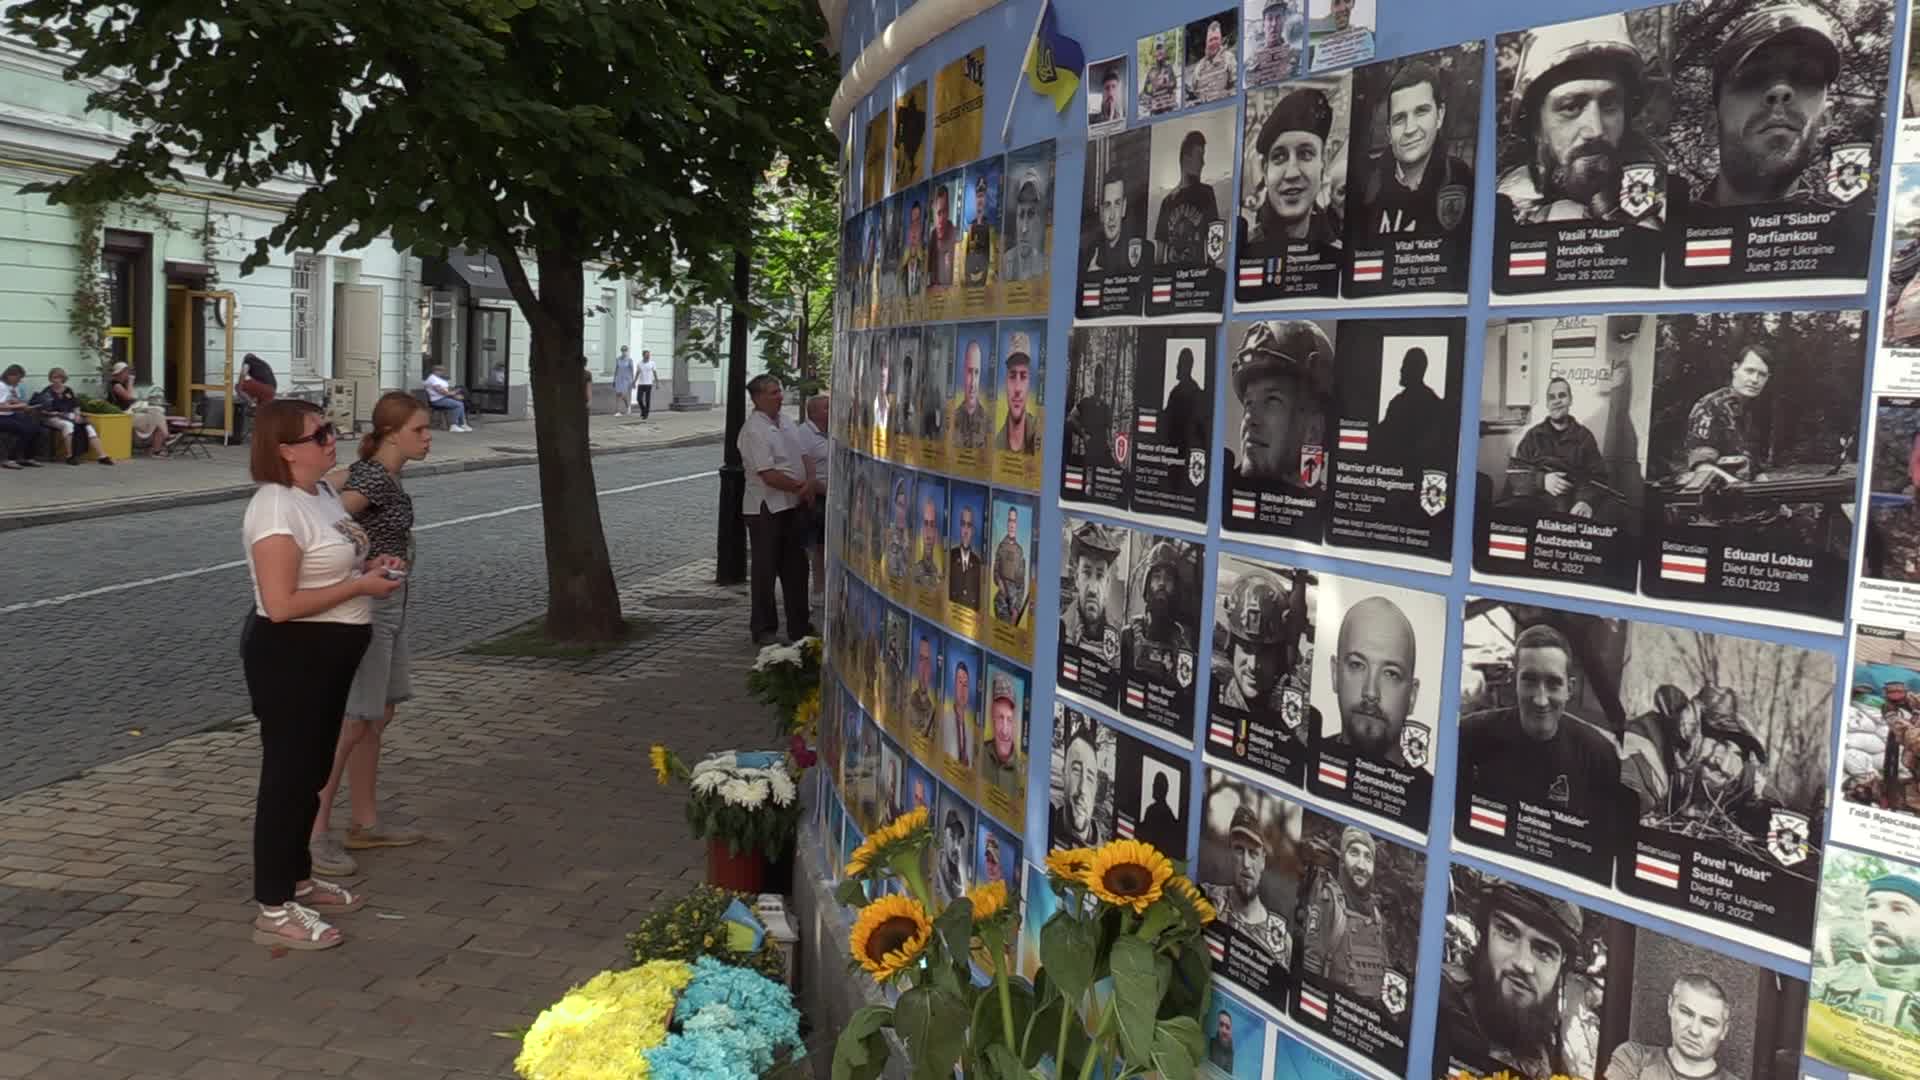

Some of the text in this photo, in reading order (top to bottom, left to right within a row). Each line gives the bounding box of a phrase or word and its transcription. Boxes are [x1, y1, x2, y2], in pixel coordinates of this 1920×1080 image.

[1750, 215, 1781, 227] Vasil
[1748, 231, 1817, 244] Parfiankou
[1747, 244, 1835, 258] Died For Ukraine
[1556, 259, 1576, 268] Died
[1594, 257, 1628, 267] Ukraine
[1745, 262, 1771, 272] June
[1790, 259, 1818, 270] 2022
[1556, 272, 1576, 280] June
[1592, 270, 1615, 280] 2022
[1337, 461, 1365, 473] Warrior
[1662, 541, 1708, 554] Belarusian
[1534, 546, 1553, 557] Died
[1569, 551, 1602, 564] Ukraine
[1723, 547, 1813, 568] Eduard Lobau
[1533, 559, 1549, 570] Dec
[1722, 562, 1809, 582] Died for Ukraine
[1721, 576, 1781, 592] 26.01.2023
[1693, 851, 1772, 882] Pavel "Volat"
[1692, 866, 1734, 889] Suslau
[1690, 881, 1775, 914] Died For Ukraine
[1689, 894, 1710, 910] May
[1727, 905, 1755, 922] 2022
